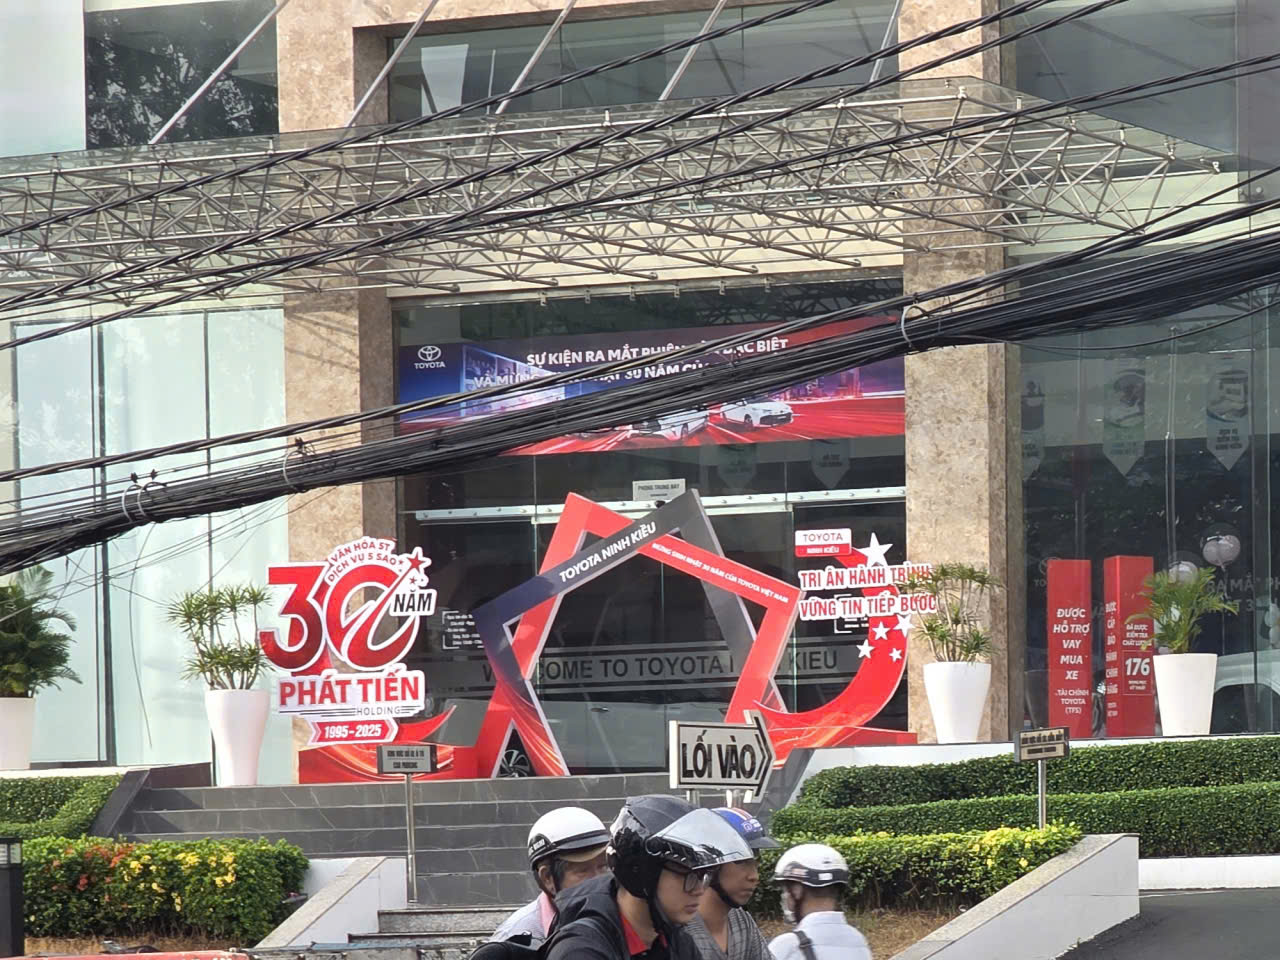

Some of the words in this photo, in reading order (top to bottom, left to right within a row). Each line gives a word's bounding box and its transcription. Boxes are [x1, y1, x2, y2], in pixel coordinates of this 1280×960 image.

[526, 351, 547, 368] SỰ
[548, 349, 583, 367] KIỆN
[586, 350, 606, 362] RA
[608, 344, 639, 361] MẮT
[757, 337, 789, 355] BIỆT
[414, 361, 446, 369] TOYOTA
[473, 370, 493, 388] VÀ
[645, 364, 680, 378] NĂM
[803, 533, 843, 542] TOYOTA
[331, 546, 352, 562] VĂN
[353, 540, 376, 552] HÓA
[559, 553, 602, 582] TOYOTA
[601, 536, 631, 560] NINH
[630, 521, 656, 543] KIỀU
[328, 561, 349, 582] DỊCH
[350, 553, 364, 564] VỤ
[376, 553, 397, 565] SAO
[801, 572, 821, 587] TRI
[826, 567, 844, 586] ÂN
[849, 565, 886, 586] HÀNH
[393, 588, 432, 612] NĂM
[738, 578, 760, 592] TOYOTA
[760, 587, 774, 597] VIỆT
[774, 594, 789, 603] NAM
[800, 598, 836, 617] VỮNG
[841, 600, 862, 615] TIN
[867, 592, 895, 614] TIẾP
[901, 592, 936, 612] BƯỚC
[1056, 608, 1085, 620] ĐƯỢC
[259, 565, 418, 671] 30
[1053, 620, 1069, 633] HỖ
[1071, 623, 1090, 635] TRỢ
[1062, 640, 1082, 649] VAY
[600, 658, 628, 677] TO
[635, 654, 723, 676] TOYOTA
[1060, 655, 1083, 665] MUA
[1125, 658, 1150, 675] 176
[1065, 671, 1079, 680] XE
[279, 670, 351, 705] PHÁT
[357, 669, 419, 702] TIẾN
[357, 706, 400, 715] HOLDING
[682, 730, 712, 778] LỐI
[716, 735, 756, 779] VÀO
